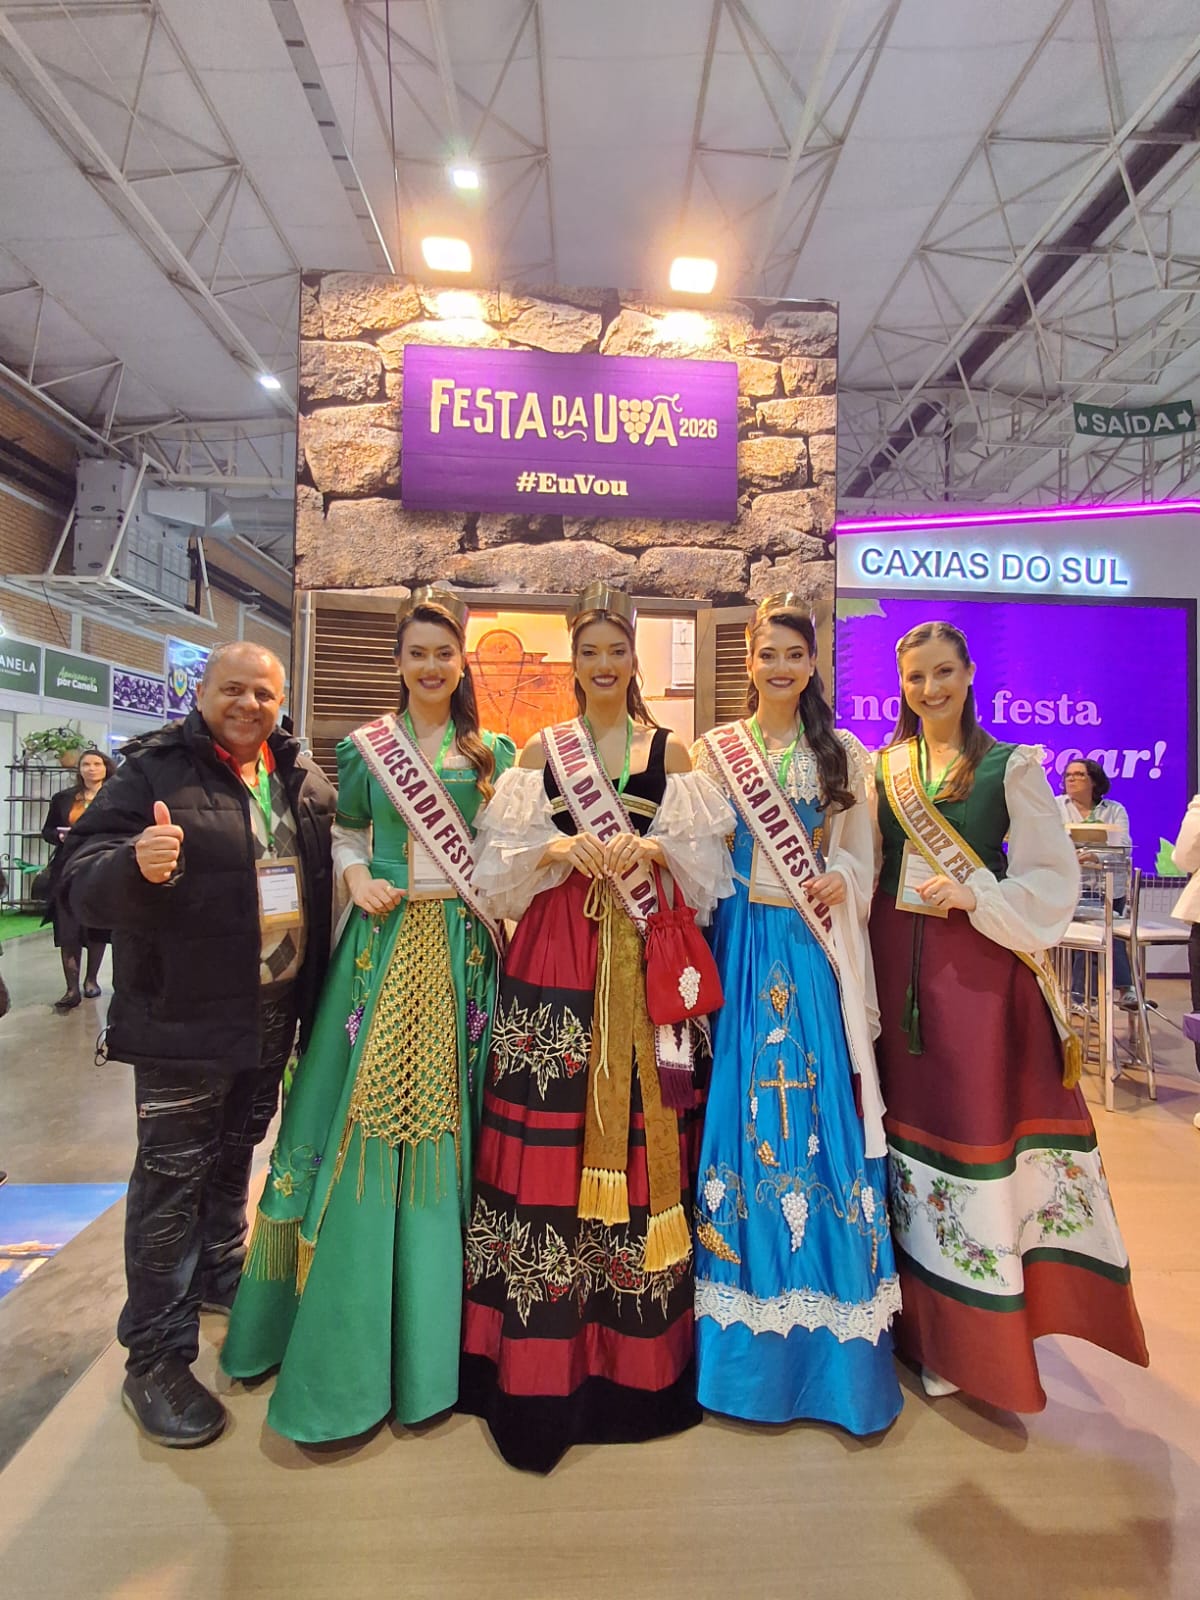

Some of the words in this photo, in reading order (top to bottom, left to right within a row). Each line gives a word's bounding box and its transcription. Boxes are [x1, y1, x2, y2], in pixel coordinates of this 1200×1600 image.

[430, 379, 547, 440] FESTA
[552, 395, 588, 428] DA
[678, 418, 719, 440] 2026
[1091, 411, 1176, 434] SAÍDA
[515, 471, 629, 496] #EuVou
[860, 547, 990, 580] CAXIAS
[1001, 552, 1052, 583] DO
[1060, 556, 1129, 586] SUL
[0, 655, 37, 674] ANELA
[57, 677, 71, 688] por
[72, 680, 98, 693] Canela
[992, 690, 1102, 726] festa
[365, 718, 428, 802] PRINCESA
[413, 793, 446, 831] DA
[713, 726, 772, 810] PRINCESA
[758, 804, 790, 840] DA
[775, 834, 816, 904] FEST
[572, 775, 602, 811] DA
[630, 880, 657, 917] DA
[943, 851, 977, 884] FES
